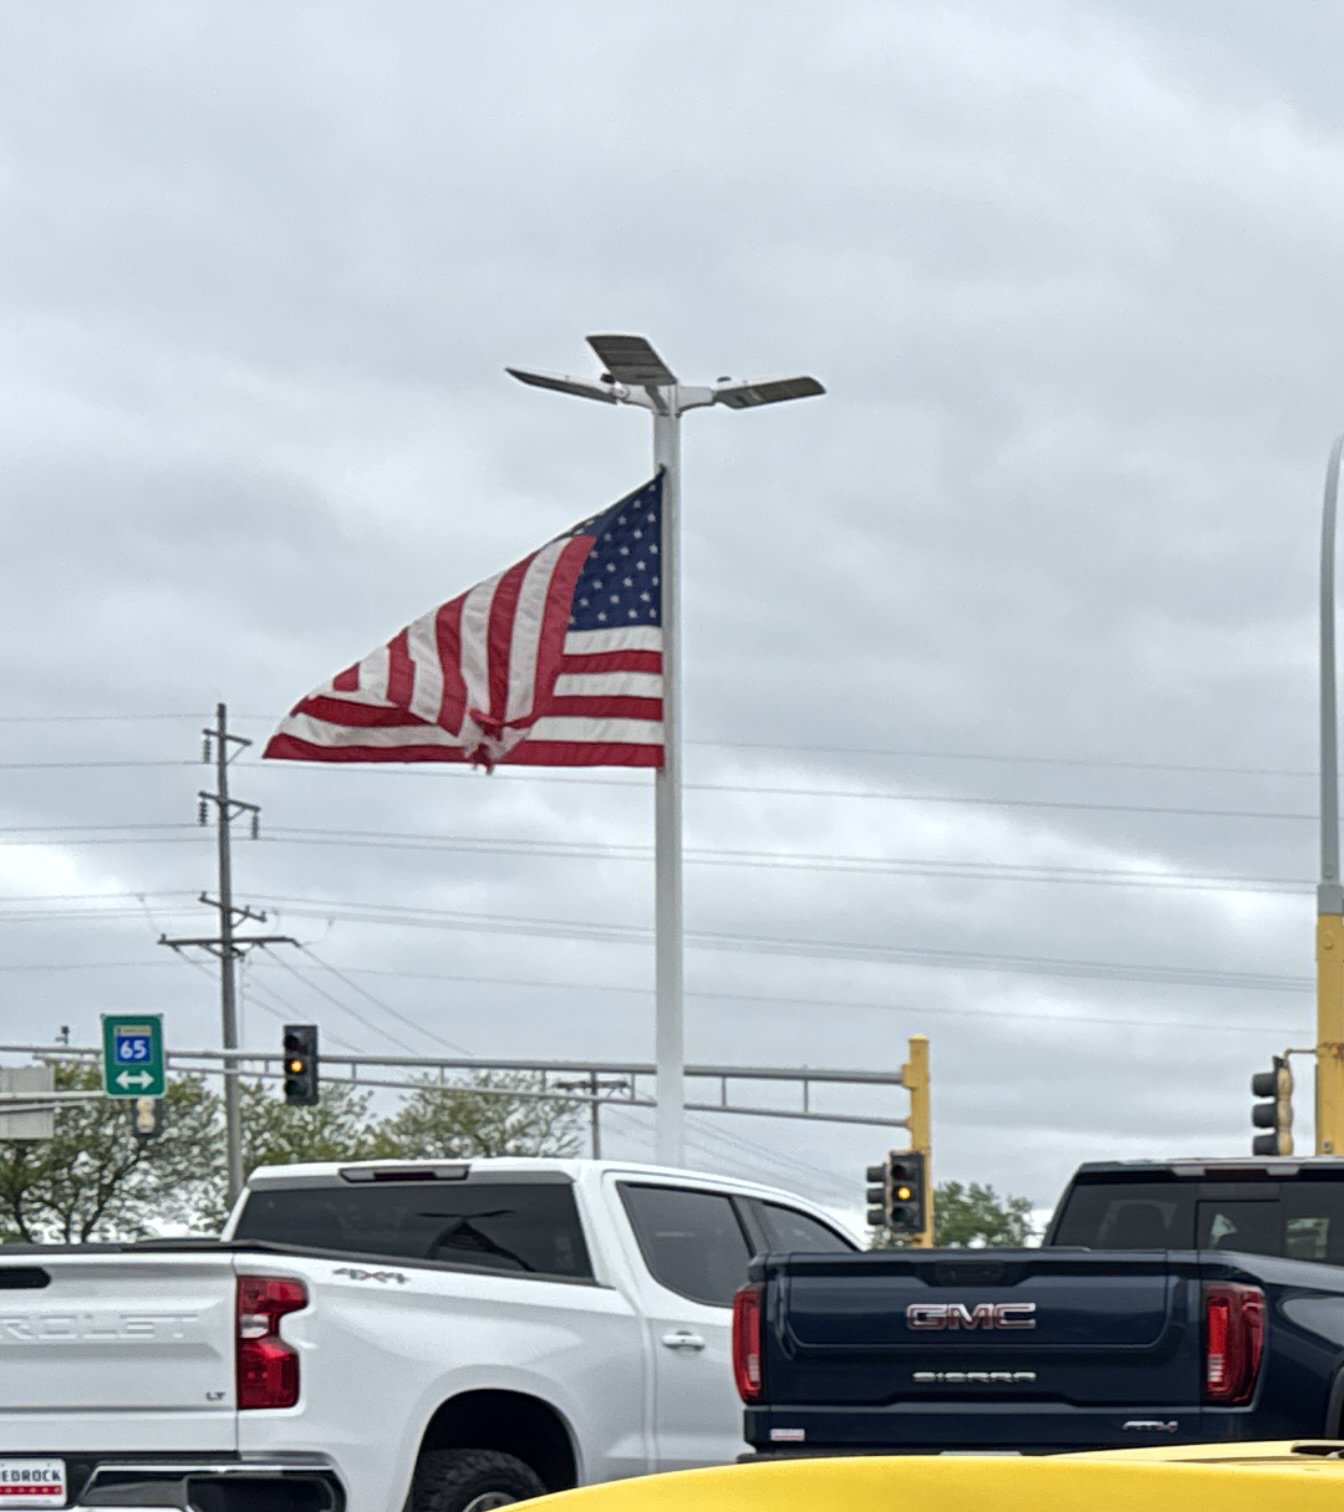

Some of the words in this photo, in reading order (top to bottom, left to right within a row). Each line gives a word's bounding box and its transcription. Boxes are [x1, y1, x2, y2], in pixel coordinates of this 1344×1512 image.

[120, 1040, 147, 1059] 65
[906, 1303, 1036, 1330] GMC
[0, 1313, 198, 1340] ROLET
[912, 1371, 1037, 1383] SIERRA
[0, 1468, 61, 1482] EDROCK
